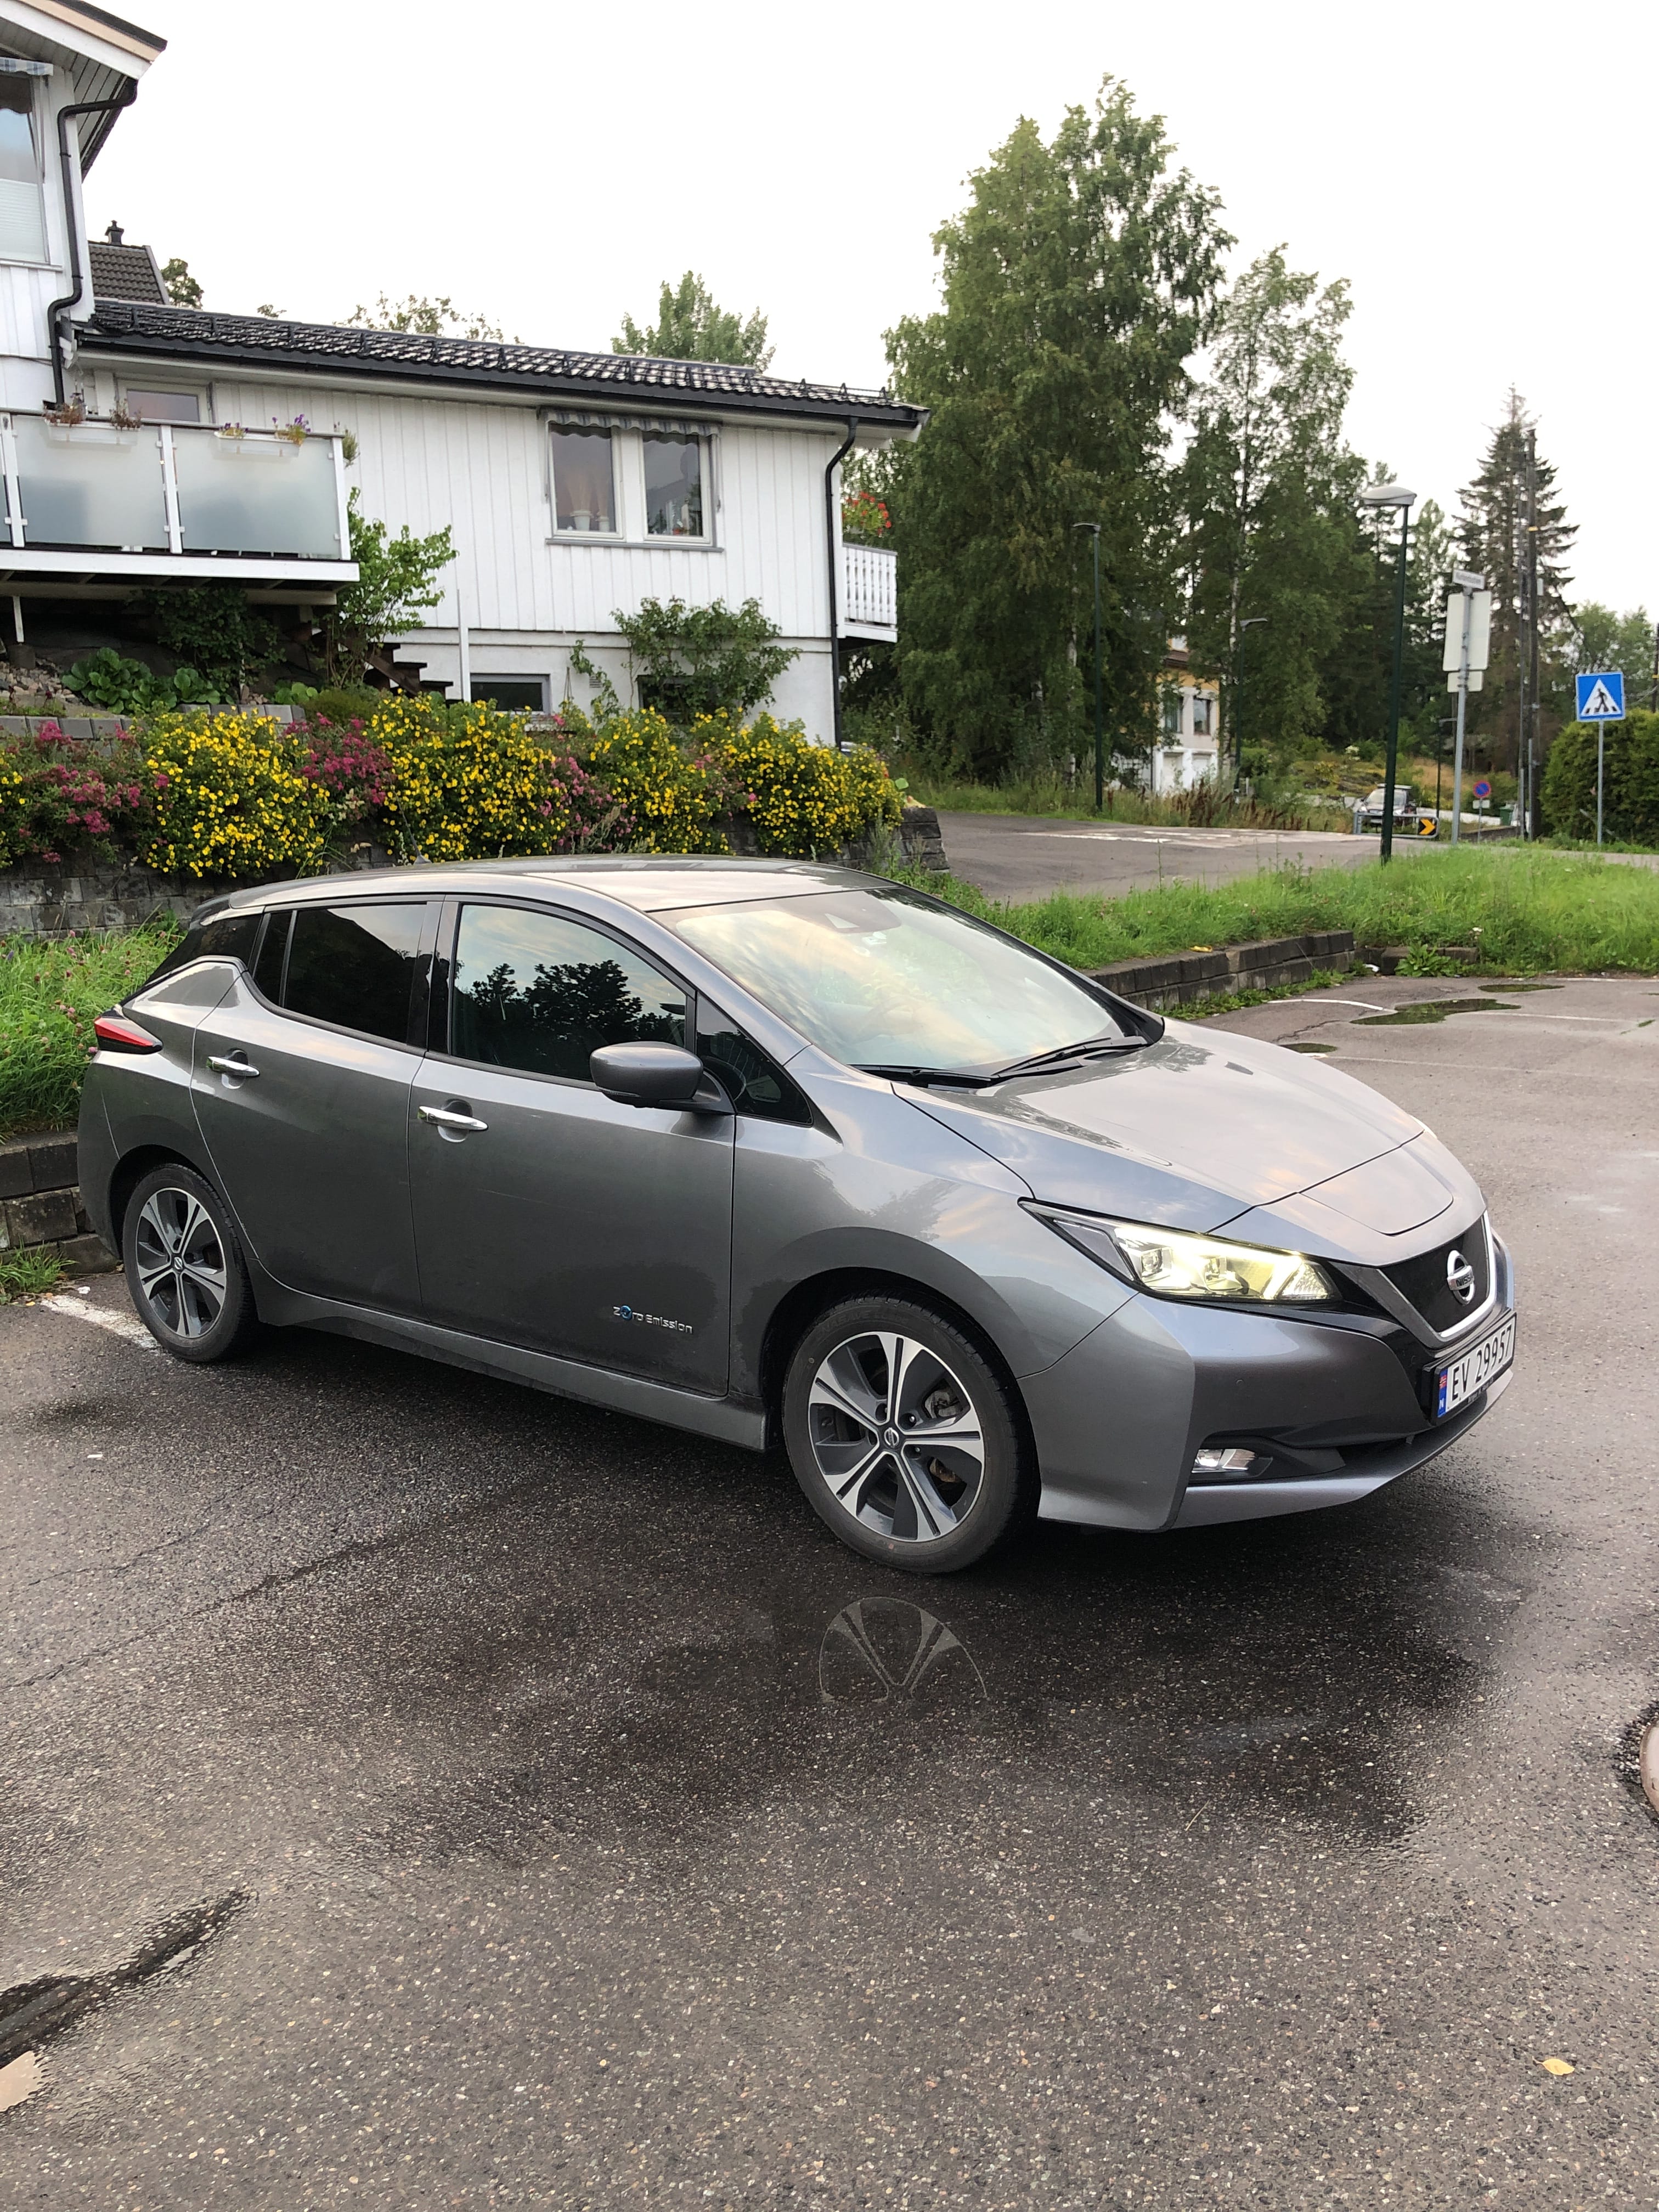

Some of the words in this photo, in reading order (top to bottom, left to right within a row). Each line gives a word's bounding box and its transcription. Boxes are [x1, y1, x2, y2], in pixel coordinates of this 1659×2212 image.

[1455, 1274, 1471, 1287] NISS
[1452, 1357, 1470, 1402] EV
[1475, 1324, 1512, 1384] 29957
[1438, 1399, 1444, 1410] N
